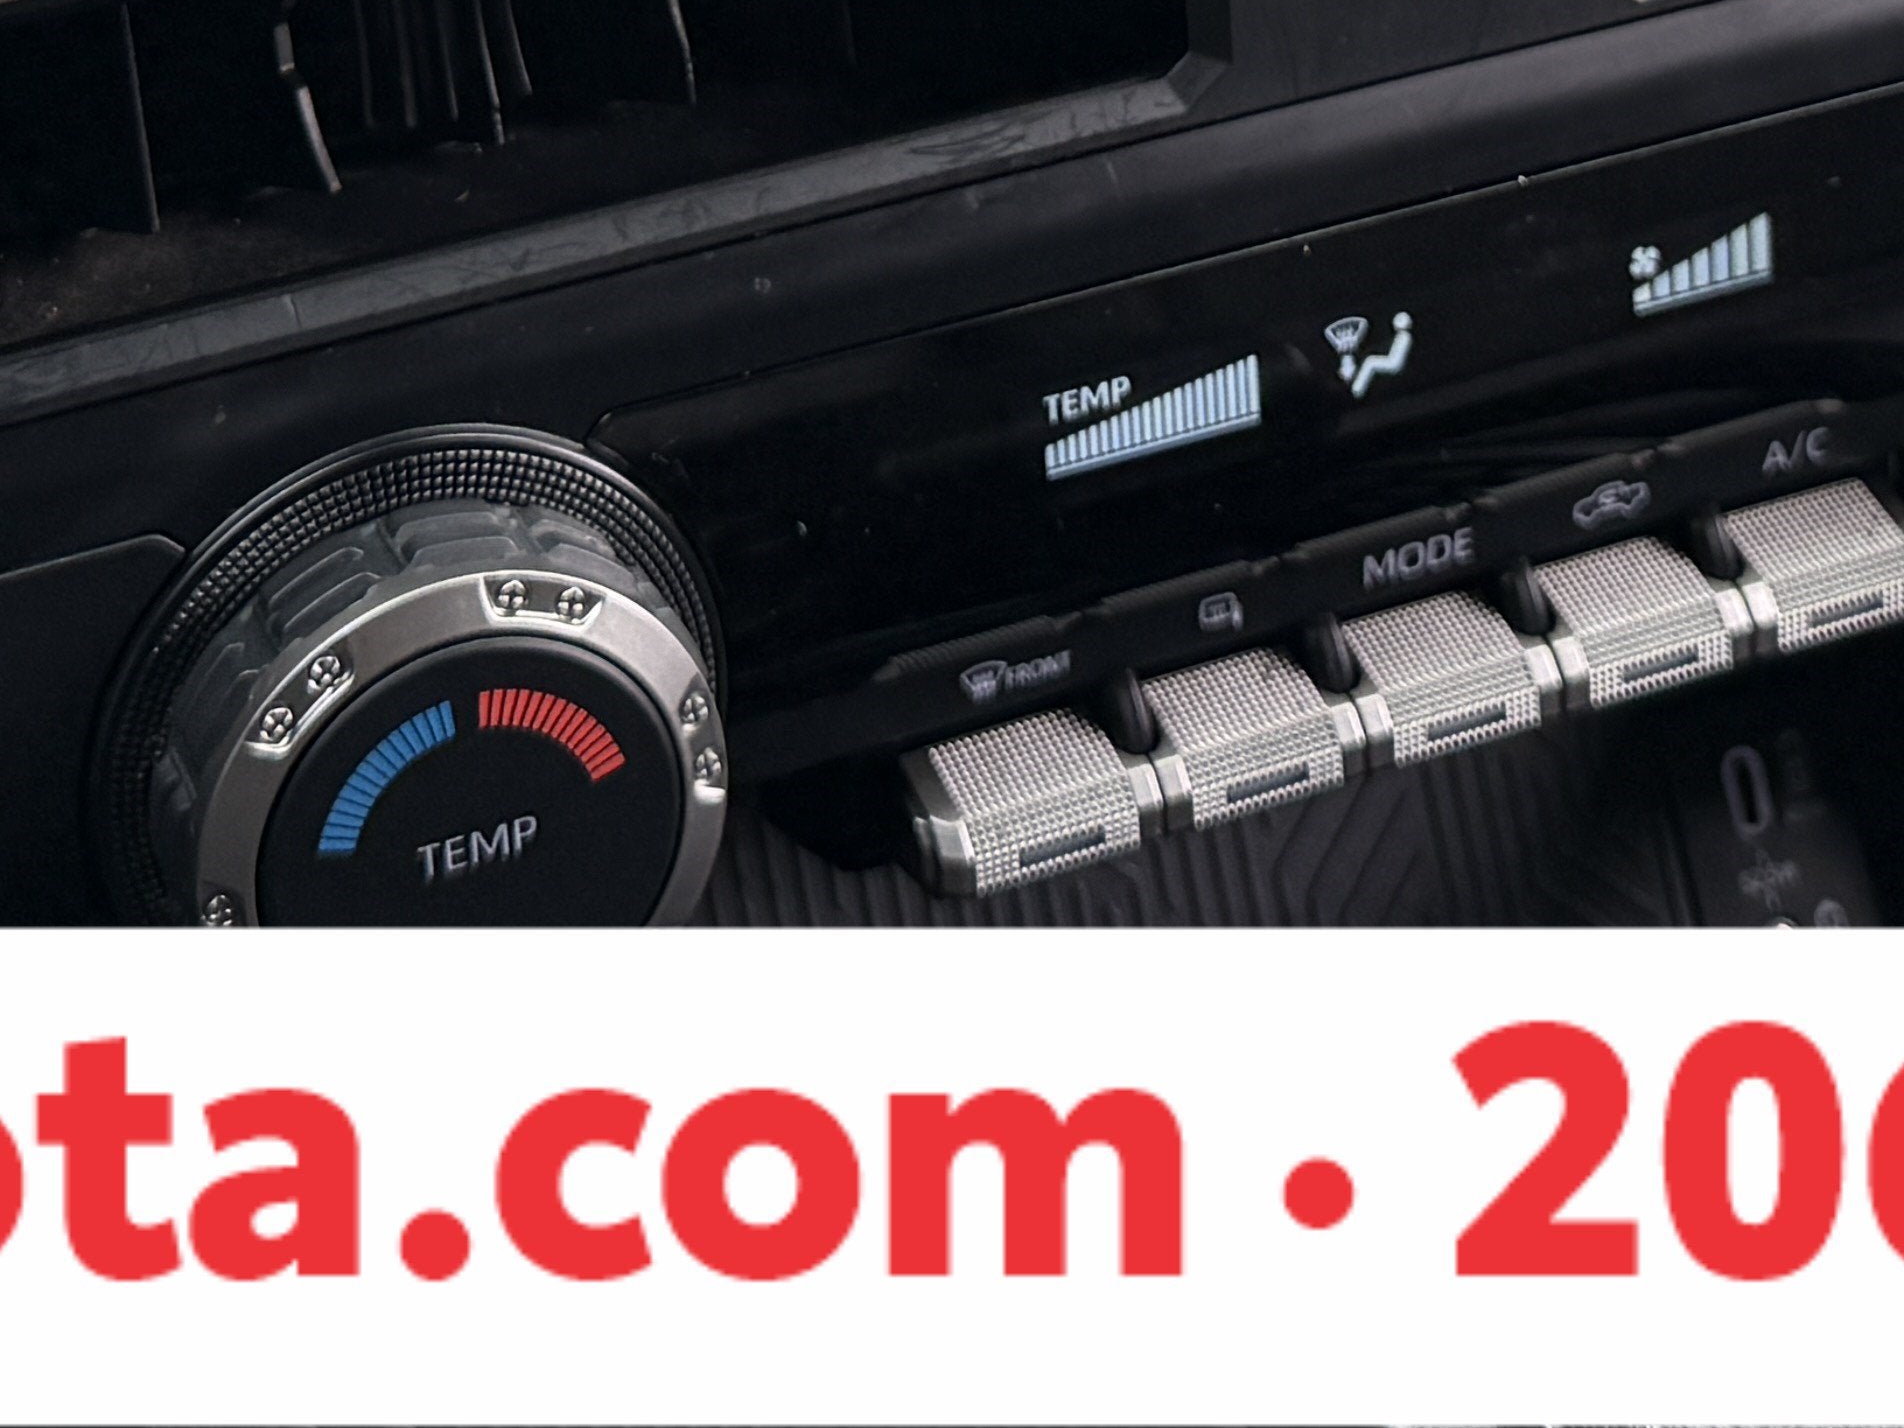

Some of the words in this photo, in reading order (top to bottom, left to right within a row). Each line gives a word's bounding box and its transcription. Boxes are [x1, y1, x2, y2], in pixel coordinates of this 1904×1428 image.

[1042, 374, 1134, 427] TEMP
[1761, 425, 1831, 473] A/C
[1362, 525, 1475, 592] MODE
[415, 814, 539, 886] TEMP
